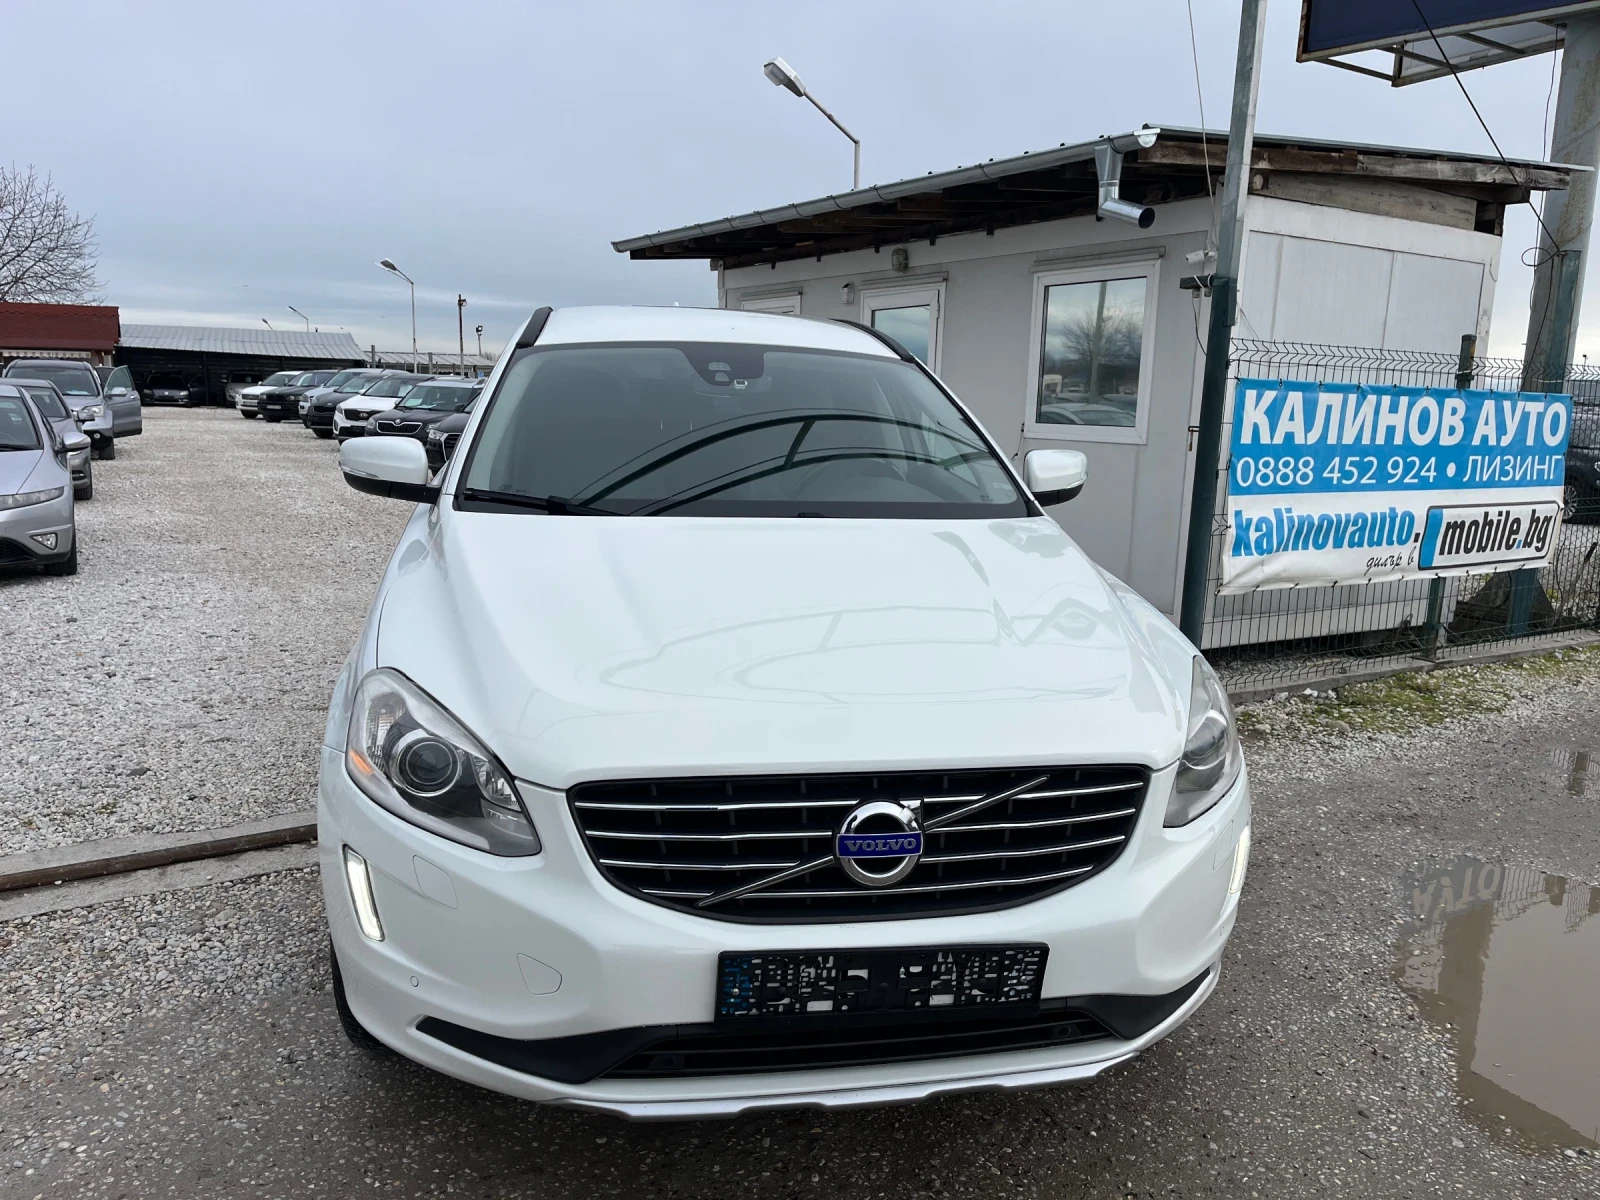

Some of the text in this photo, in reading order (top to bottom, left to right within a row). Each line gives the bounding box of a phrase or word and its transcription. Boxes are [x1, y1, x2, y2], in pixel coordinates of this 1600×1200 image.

[1240, 389, 1567, 447] КАЛИНОВ АУТО
[1236, 454, 1563, 487] 0888 452 924 ЛИЗИНГ
[1438, 508, 1553, 556] mobile.bg
[843, 837, 917, 852] VOLVO
